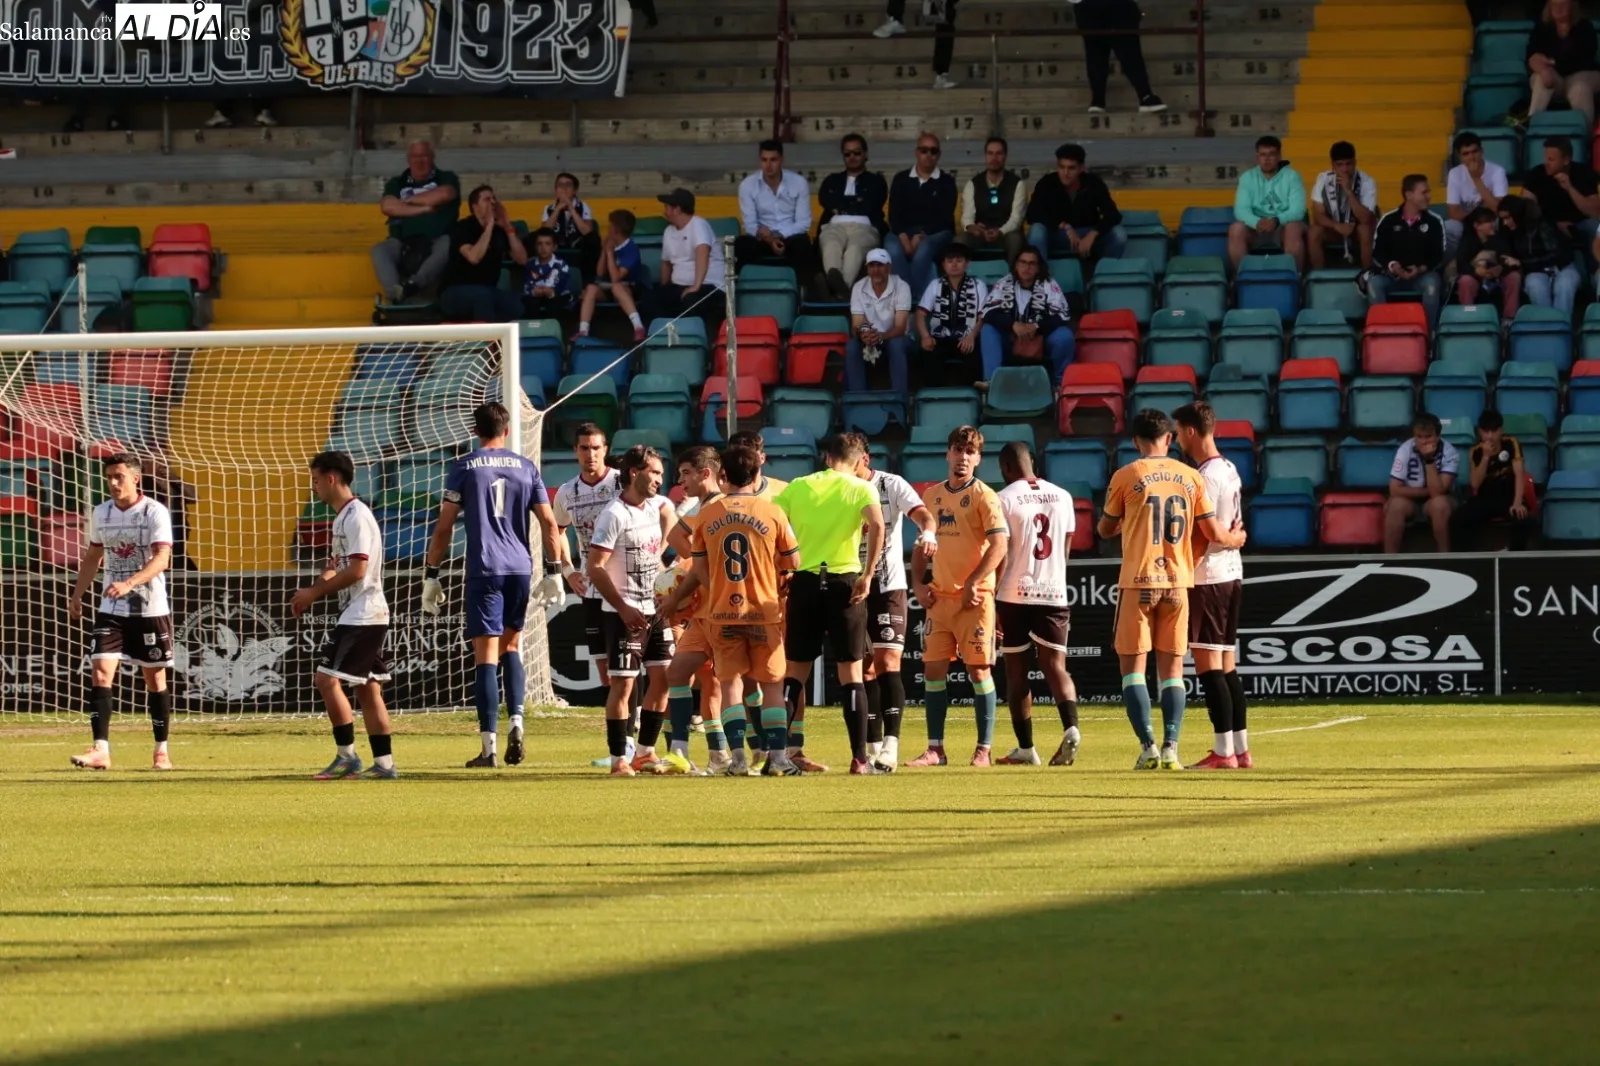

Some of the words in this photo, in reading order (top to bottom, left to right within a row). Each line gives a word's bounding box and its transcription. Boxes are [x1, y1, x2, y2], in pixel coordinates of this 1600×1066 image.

[430, 0, 617, 85] 1923
[323, 61, 395, 85] ULTRAS
[465, 456, 522, 470] J.VILLANUEVA
[491, 477, 507, 518] 1
[1133, 472, 1171, 494] SERGIO
[1145, 495, 1187, 545] 16
[1033, 513, 1053, 560] 3
[723, 531, 750, 582] 8
[1512, 584, 1599, 617] SAN
[617, 653, 632, 668] 11
[1184, 634, 1481, 664] ISCOSA
[1437, 672, 1484, 693] S.L.
